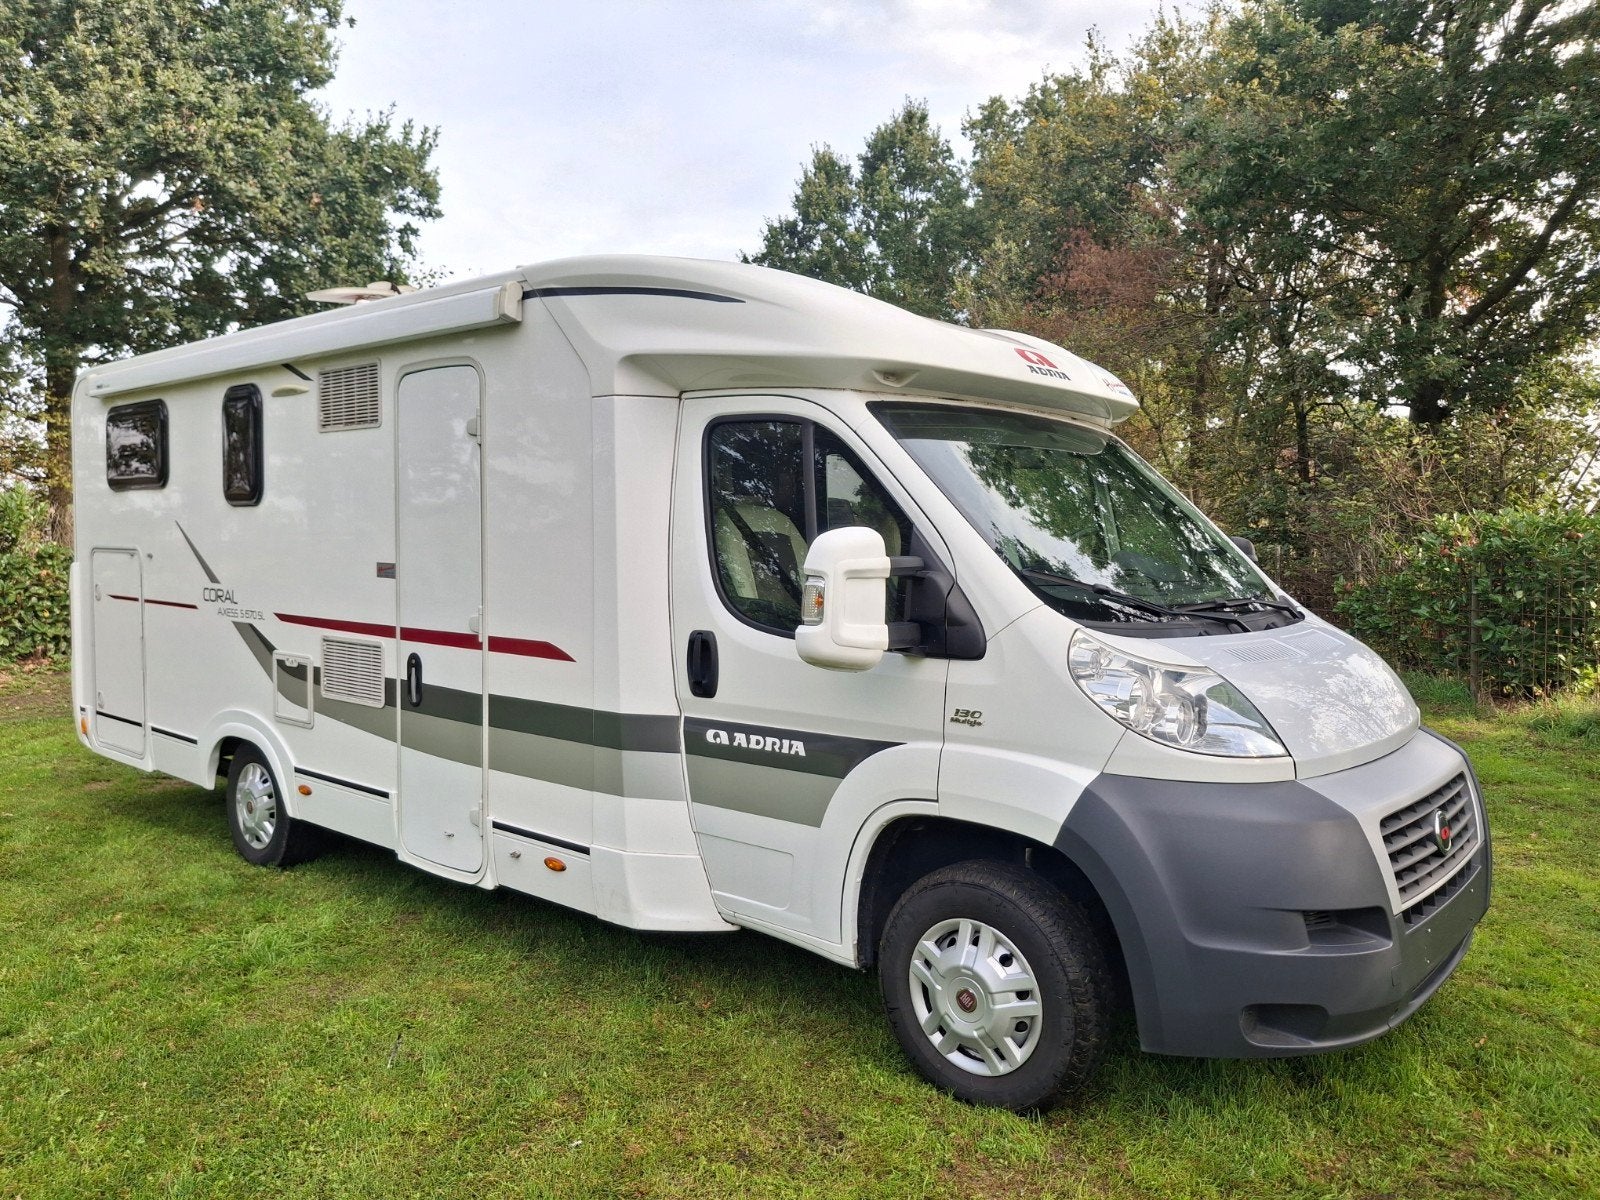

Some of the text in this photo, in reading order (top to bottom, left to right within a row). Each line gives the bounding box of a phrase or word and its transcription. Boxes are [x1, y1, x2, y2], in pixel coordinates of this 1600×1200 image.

[1026, 364, 1072, 381] ADRIA
[203, 587, 238, 604] CORAL
[954, 708, 982, 719] 130
[733, 732, 806, 757] ADRIA
